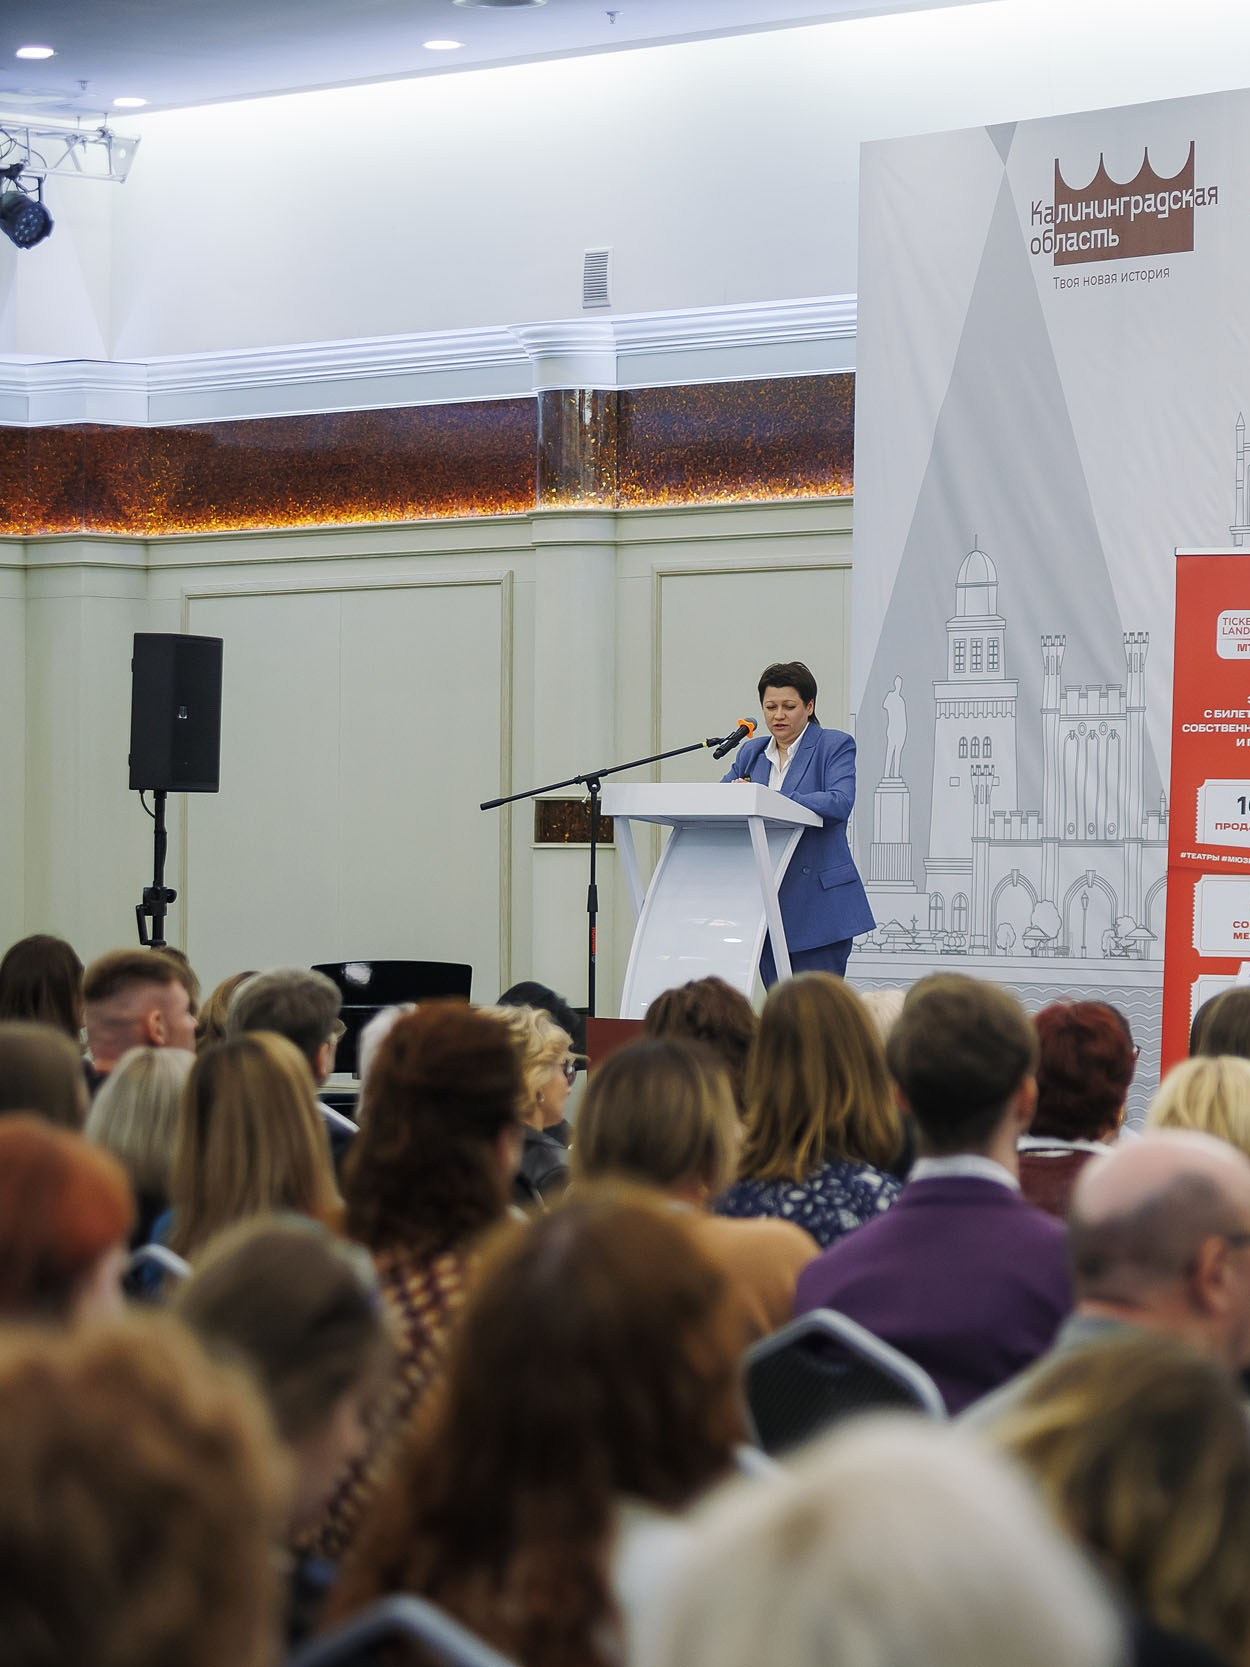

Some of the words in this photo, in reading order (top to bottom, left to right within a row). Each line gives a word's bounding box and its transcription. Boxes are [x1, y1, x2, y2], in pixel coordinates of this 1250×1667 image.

[1031, 185, 1218, 227] Калининградская
[1030, 228, 1119, 255] область
[1053, 275, 1080, 289] Твоя
[1083, 272, 1117, 287] новая
[1121, 266, 1170, 285] история
[1222, 627, 1250, 635] LAND
[1204, 710, 1212, 718] С
[1236, 738, 1245, 747] И
[1180, 852, 1220, 861] #ТЕАТРЫ
